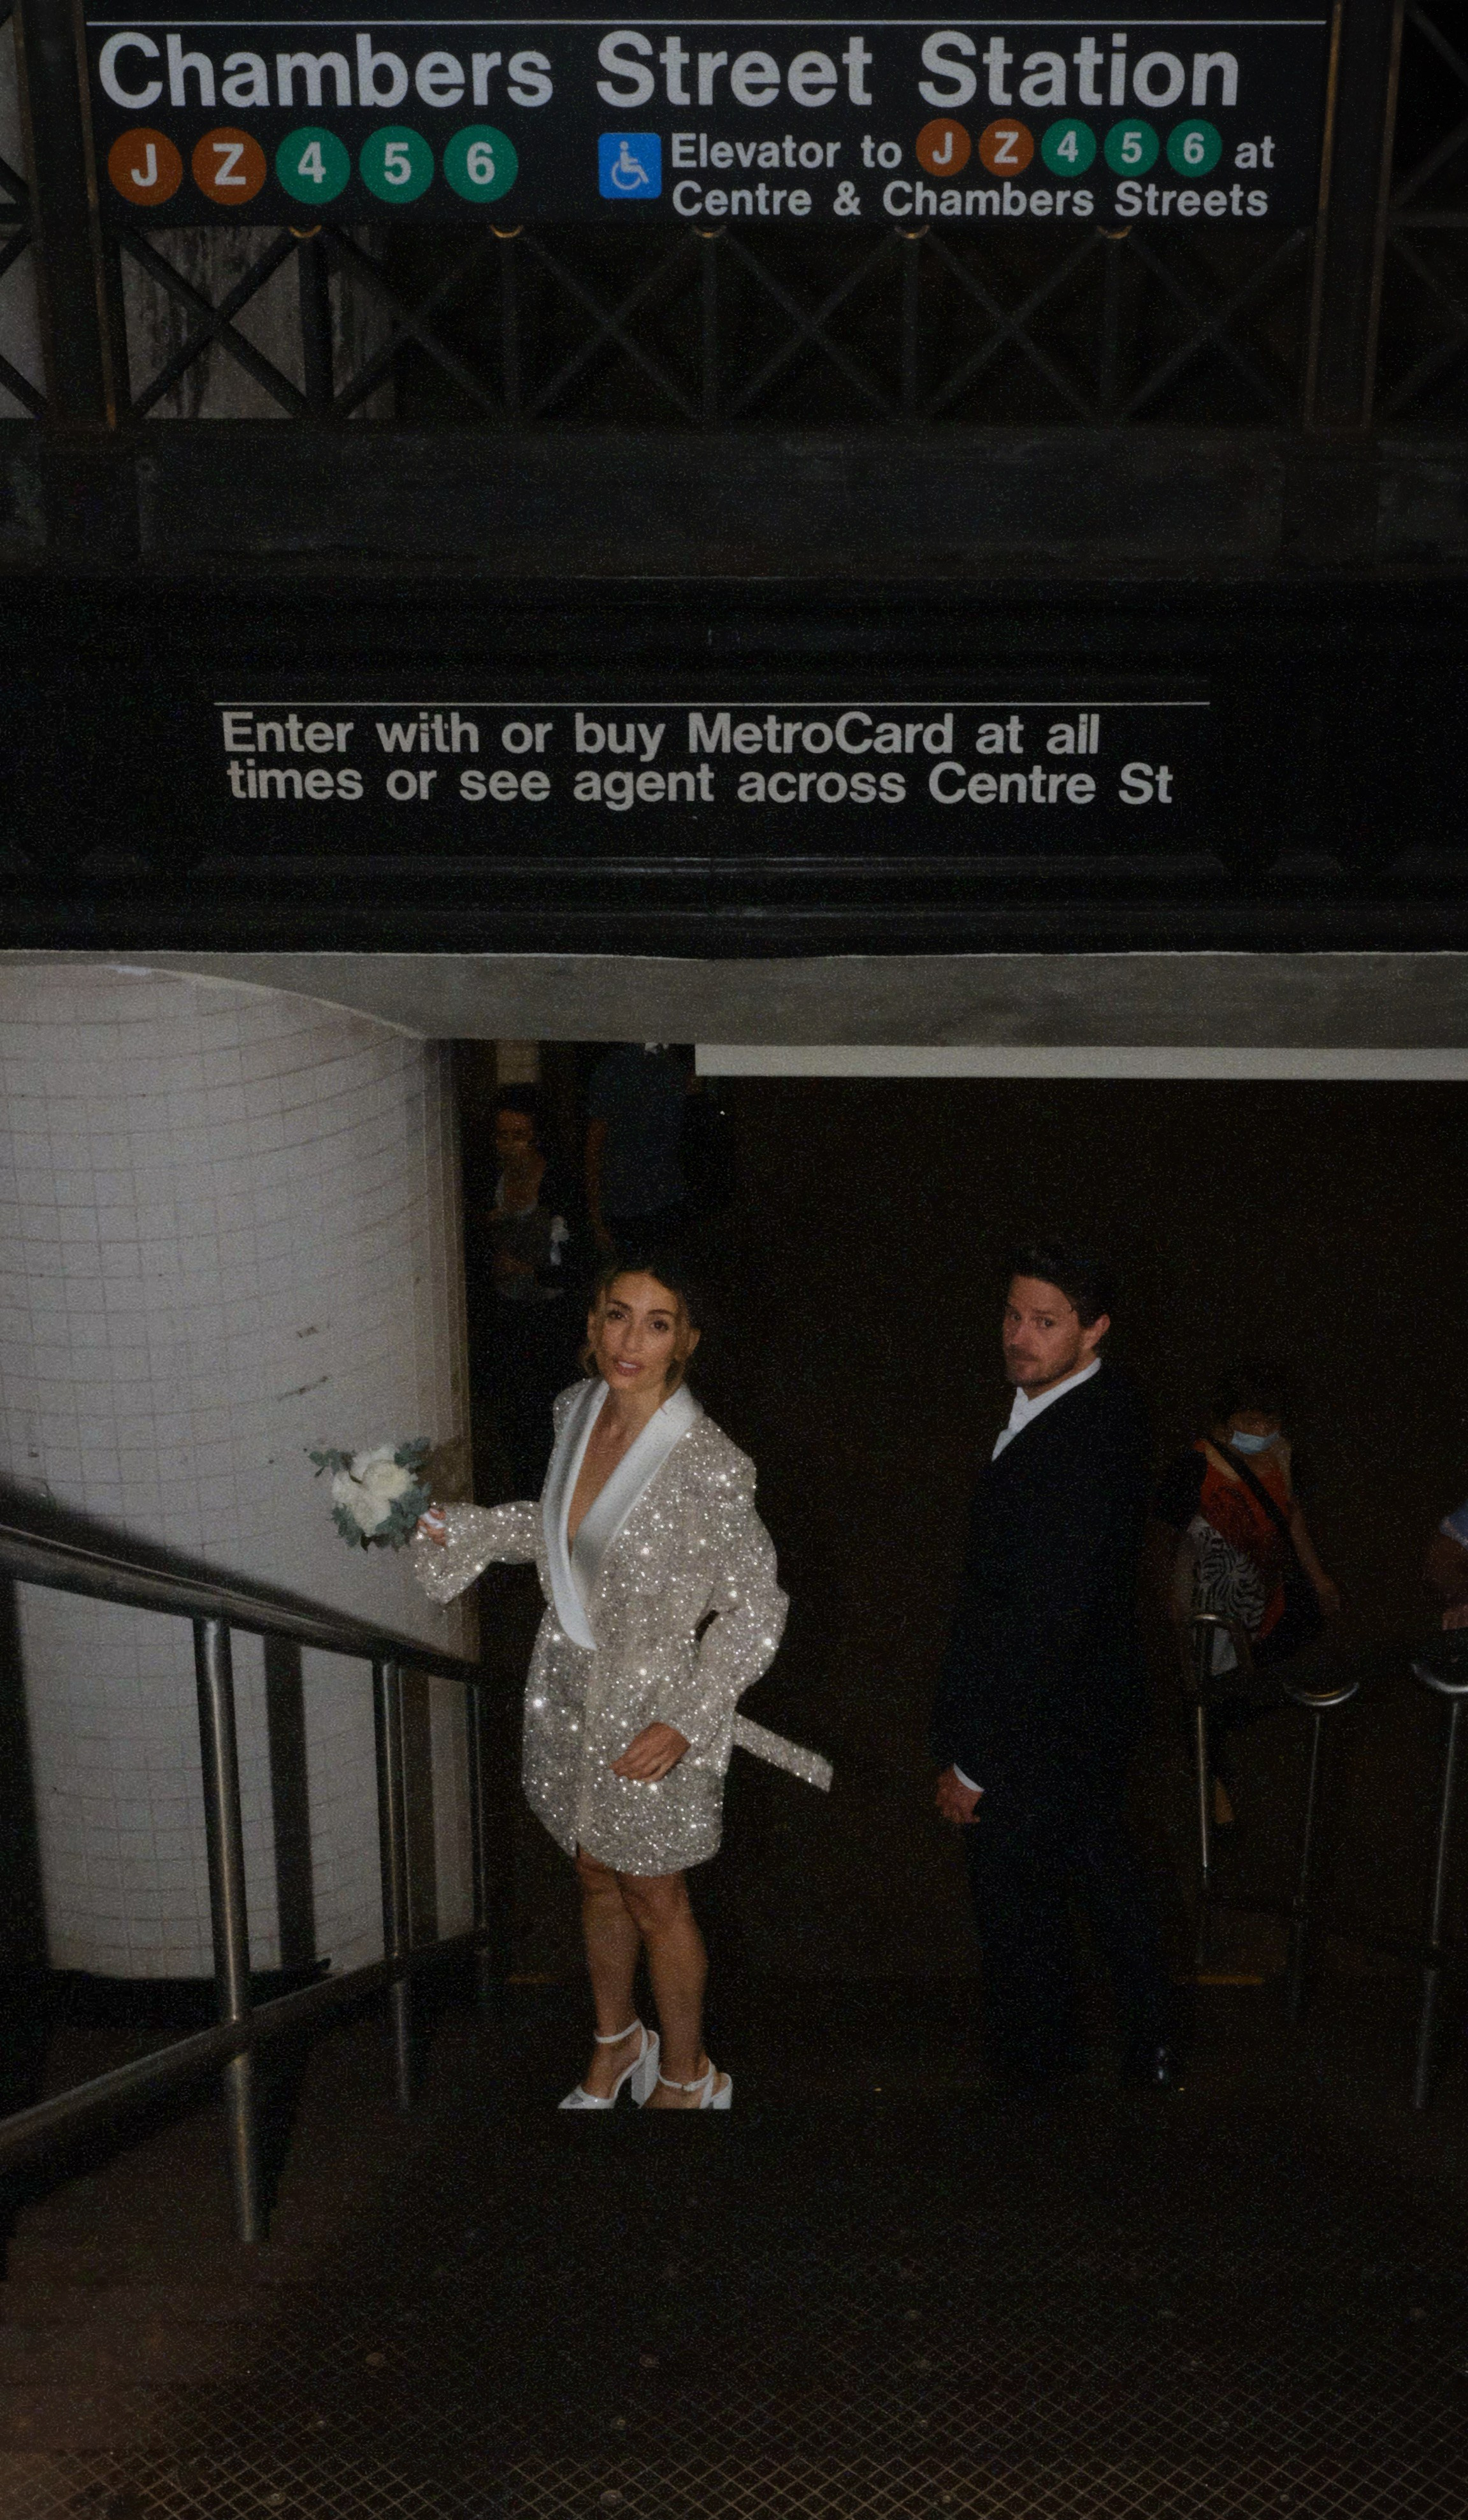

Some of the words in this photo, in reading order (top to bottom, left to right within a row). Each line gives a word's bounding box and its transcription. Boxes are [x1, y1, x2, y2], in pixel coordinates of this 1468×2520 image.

[99, 32, 553, 109] Chambers
[596, 30, 872, 108] Street
[918, 30, 1239, 108] Station
[131, 143, 158, 187] J
[213, 143, 247, 185] Z
[298, 141, 326, 184] 4
[384, 142, 412, 185] 5
[466, 141, 495, 185] 6
[672, 133, 841, 169] Elevator
[860, 134, 902, 169] to
[932, 131, 953, 165] J
[994, 131, 1019, 164] Z
[1056, 131, 1079, 162] 4
[1121, 131, 1142, 164] 5
[1183, 132, 1205, 164] 6
[1234, 135, 1276, 169] at
[672, 180, 812, 217] Centre
[833, 180, 861, 216] &
[882, 180, 1094, 217] Chambers
[1114, 180, 1268, 217] Streets
[222, 711, 354, 753] Enter
[375, 712, 479, 752] with
[501, 722, 553, 754] or
[575, 712, 666, 762] buy
[688, 711, 954, 754] MetroCard
[975, 715, 1025, 754] at
[1046, 713, 1100, 755] all
[226, 758, 364, 800] times
[386, 769, 437, 801] or
[459, 770, 551, 802] see
[573, 763, 715, 811] agent
[737, 771, 906, 803] across
[928, 761, 1096, 804] Centre
[1118, 762, 1174, 805] St
